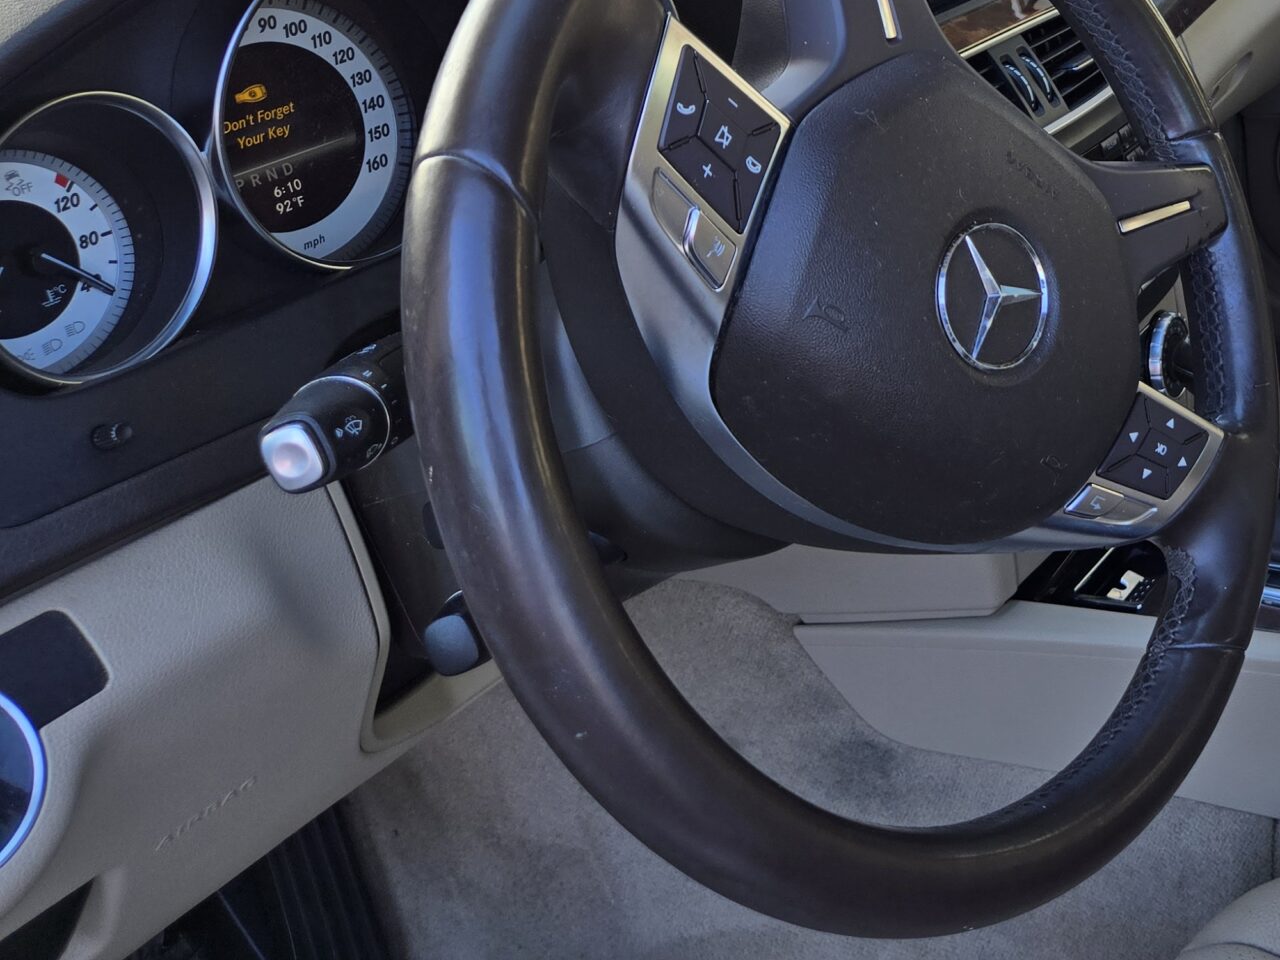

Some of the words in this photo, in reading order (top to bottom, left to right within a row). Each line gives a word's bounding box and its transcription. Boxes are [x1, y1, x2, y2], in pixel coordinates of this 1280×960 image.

[258, 15, 277, 33] 90
[283, 19, 308, 38] 100
[310, 30, 332, 49] 110
[332, 46, 355, 65] 120
[351, 69, 372, 88] 130
[361, 94, 385, 114] 140
[224, 114, 255, 134] Don't
[257, 101, 295, 123] Forget
[237, 132, 266, 150] Your
[268, 124, 290, 140] Key
[368, 123, 390, 143] 150
[366, 153, 388, 173] 160
[250, 174, 262, 187] R
[266, 168, 279, 182] N
[282, 162, 294, 176] D
[11, 181, 34, 197] OFF
[273, 178, 302, 198] 6:10
[54, 192, 80, 213] 120
[275, 195, 305, 215] 92°F
[79, 230, 99, 249] 80
[303, 233, 326, 251] mph
[1154, 441, 1168, 456] OK
